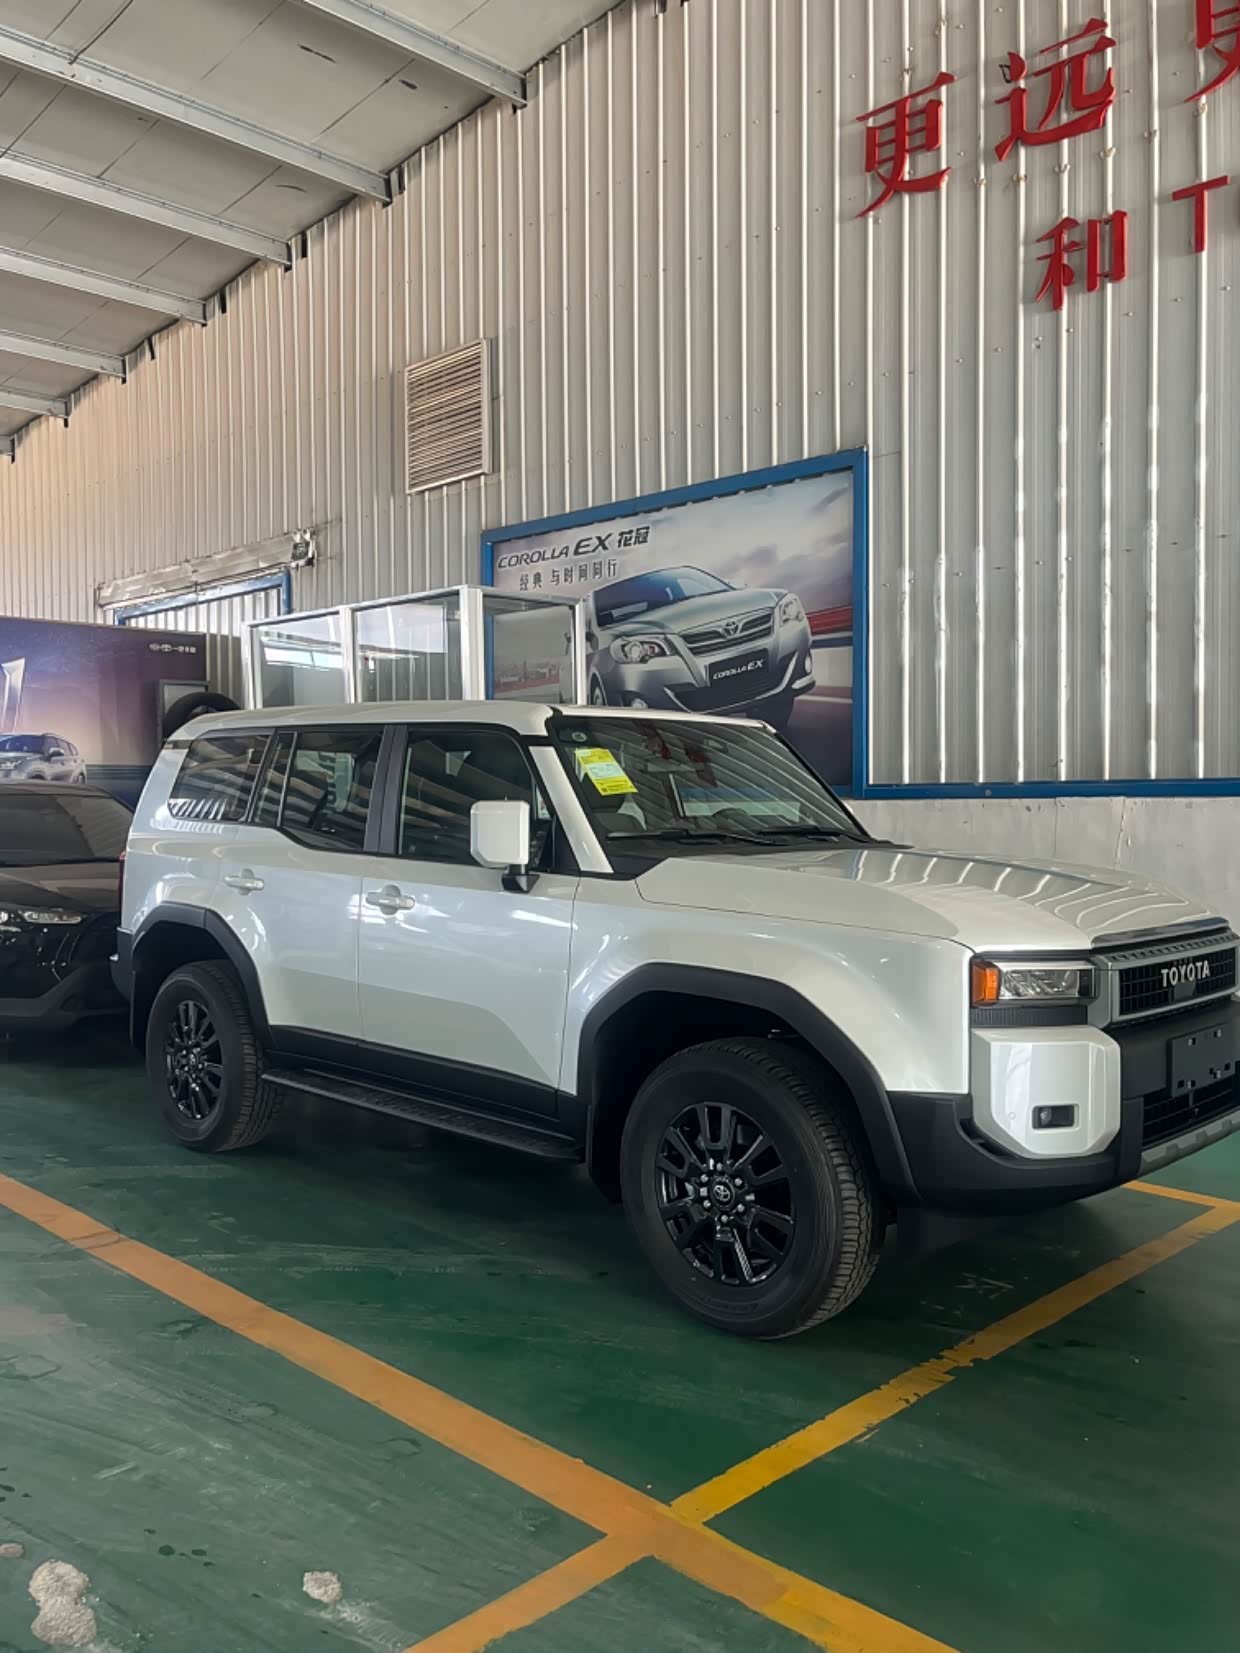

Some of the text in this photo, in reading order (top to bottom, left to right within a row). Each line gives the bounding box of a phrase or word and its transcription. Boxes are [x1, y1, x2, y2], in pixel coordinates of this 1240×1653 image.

[498, 525, 650, 569] COROLLA EX 花冠
[1160, 960, 1211, 988] TOYOTA
